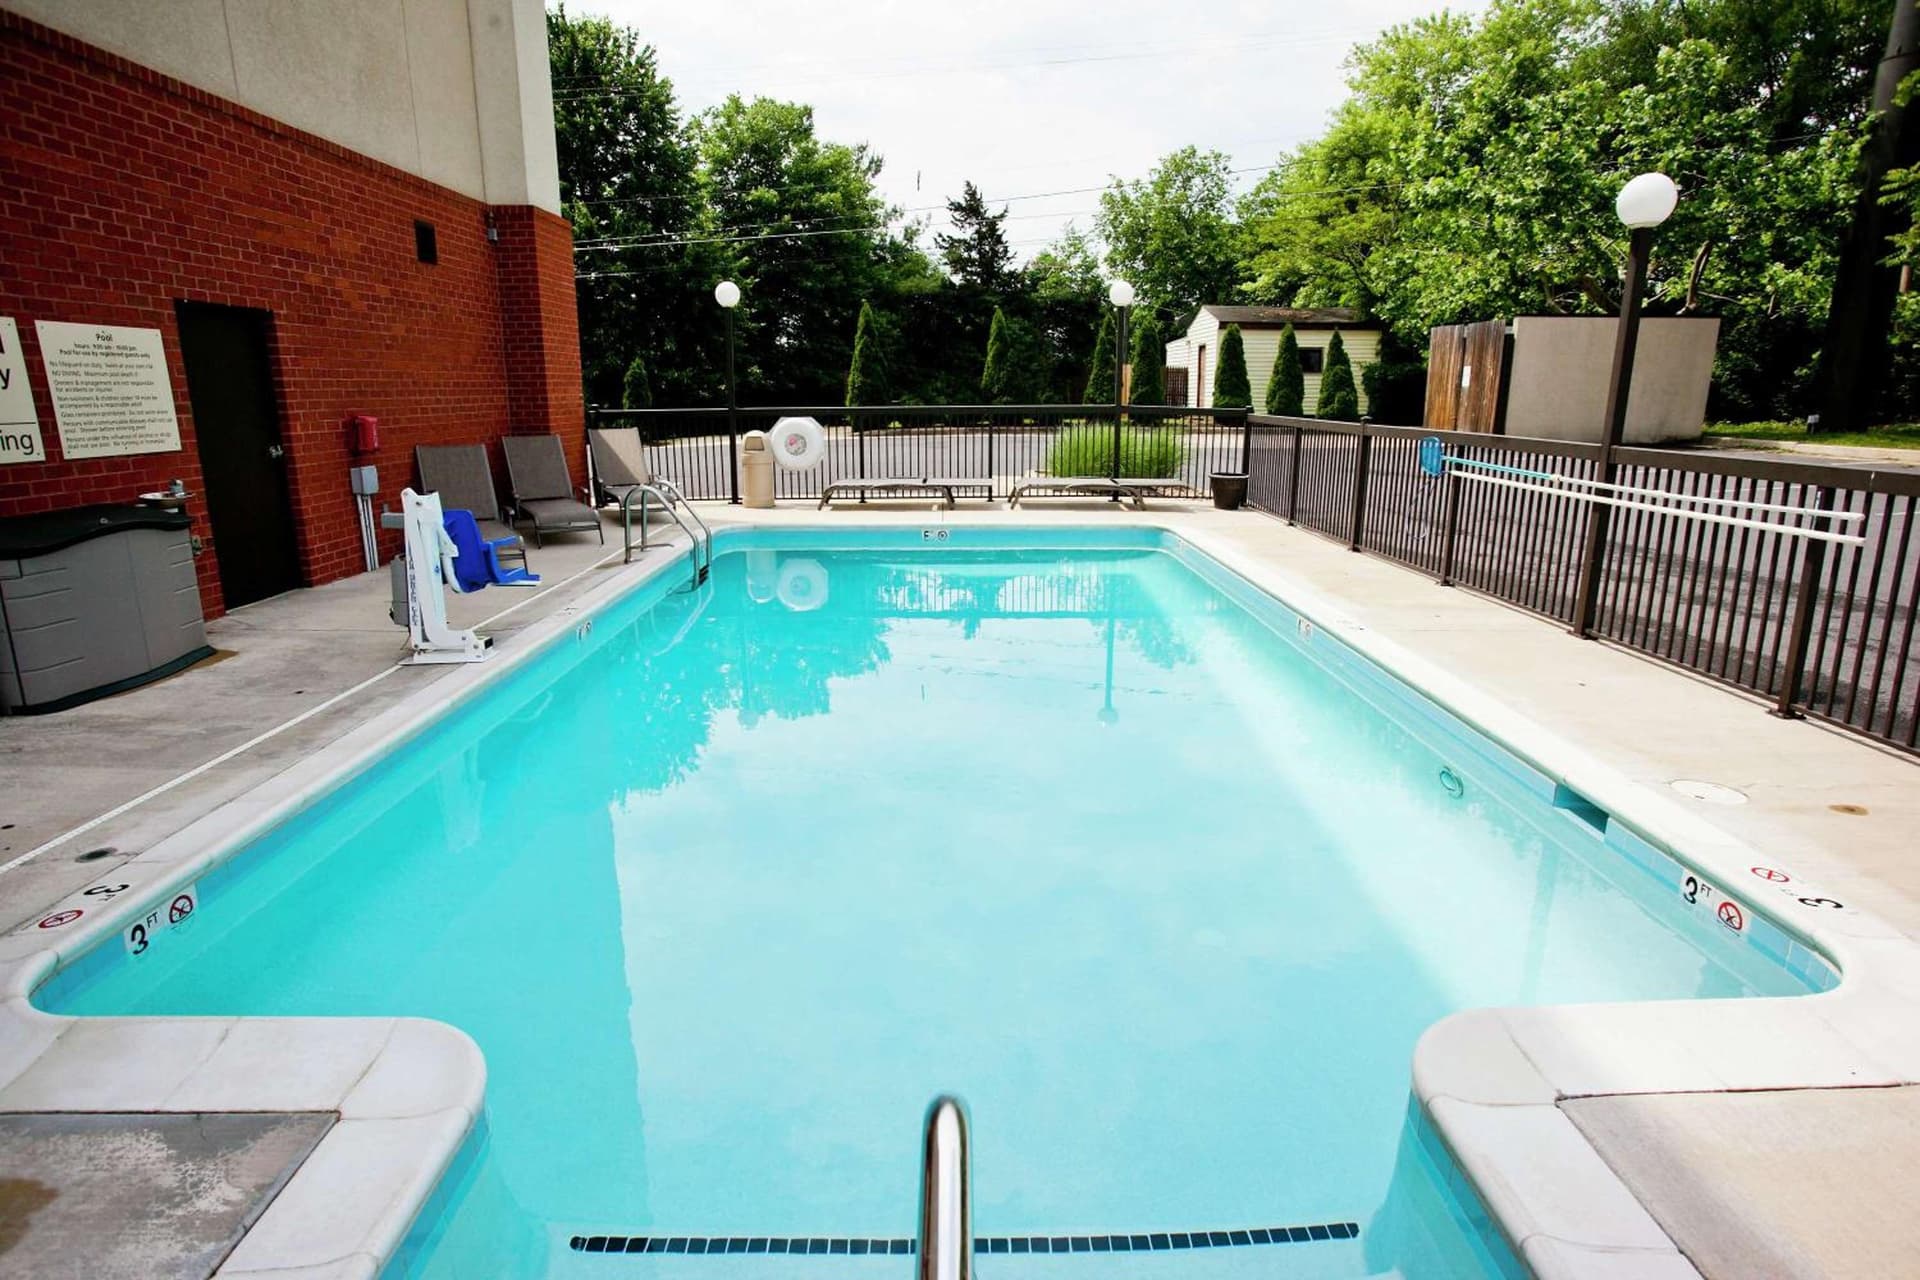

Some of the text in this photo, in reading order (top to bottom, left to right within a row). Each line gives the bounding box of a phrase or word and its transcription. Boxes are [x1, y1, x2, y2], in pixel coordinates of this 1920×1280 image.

[95, 333, 112, 341] Pool
[83, 884, 130, 896] 3
[1683, 876, 1712, 905] 3 FT
[1797, 898, 1844, 909] 3
[131, 911, 159, 955] 3 FT
